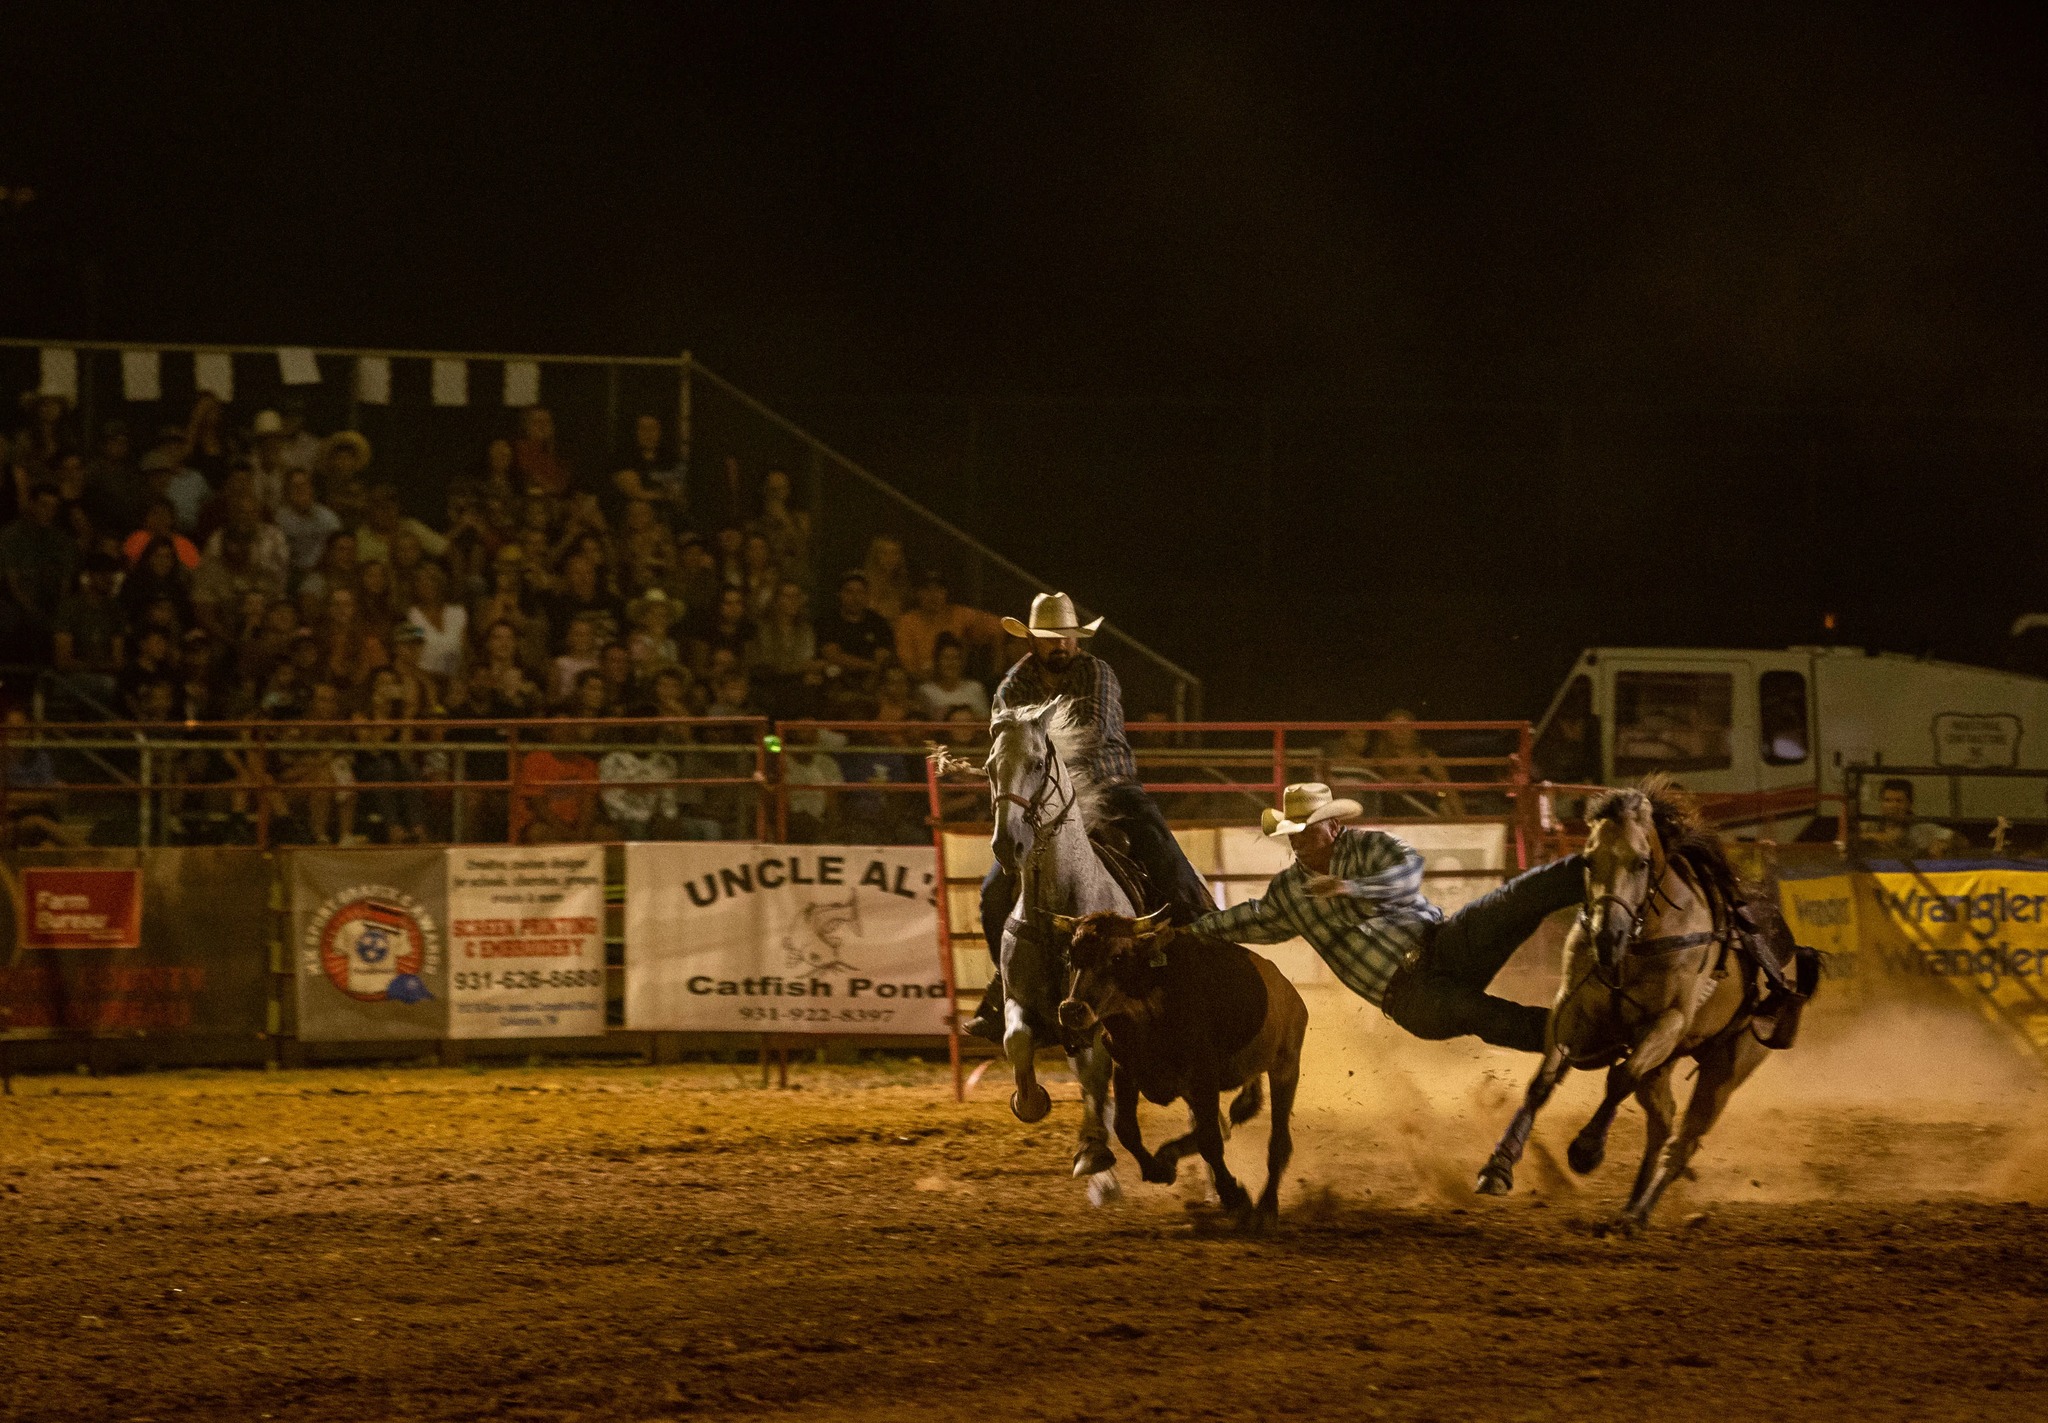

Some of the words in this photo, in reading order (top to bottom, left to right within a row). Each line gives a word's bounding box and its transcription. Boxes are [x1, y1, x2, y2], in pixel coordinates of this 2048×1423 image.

[684, 856, 845, 906] UNCLE
[1873, 886, 2048, 940] Wrangler
[452, 919, 516, 938] SCREEN
[520, 917, 597, 937] PRINTING
[686, 976, 833, 997] Catfish
[850, 978, 947, 999] Pond
[739, 1006, 895, 1023] 931-922-8397
